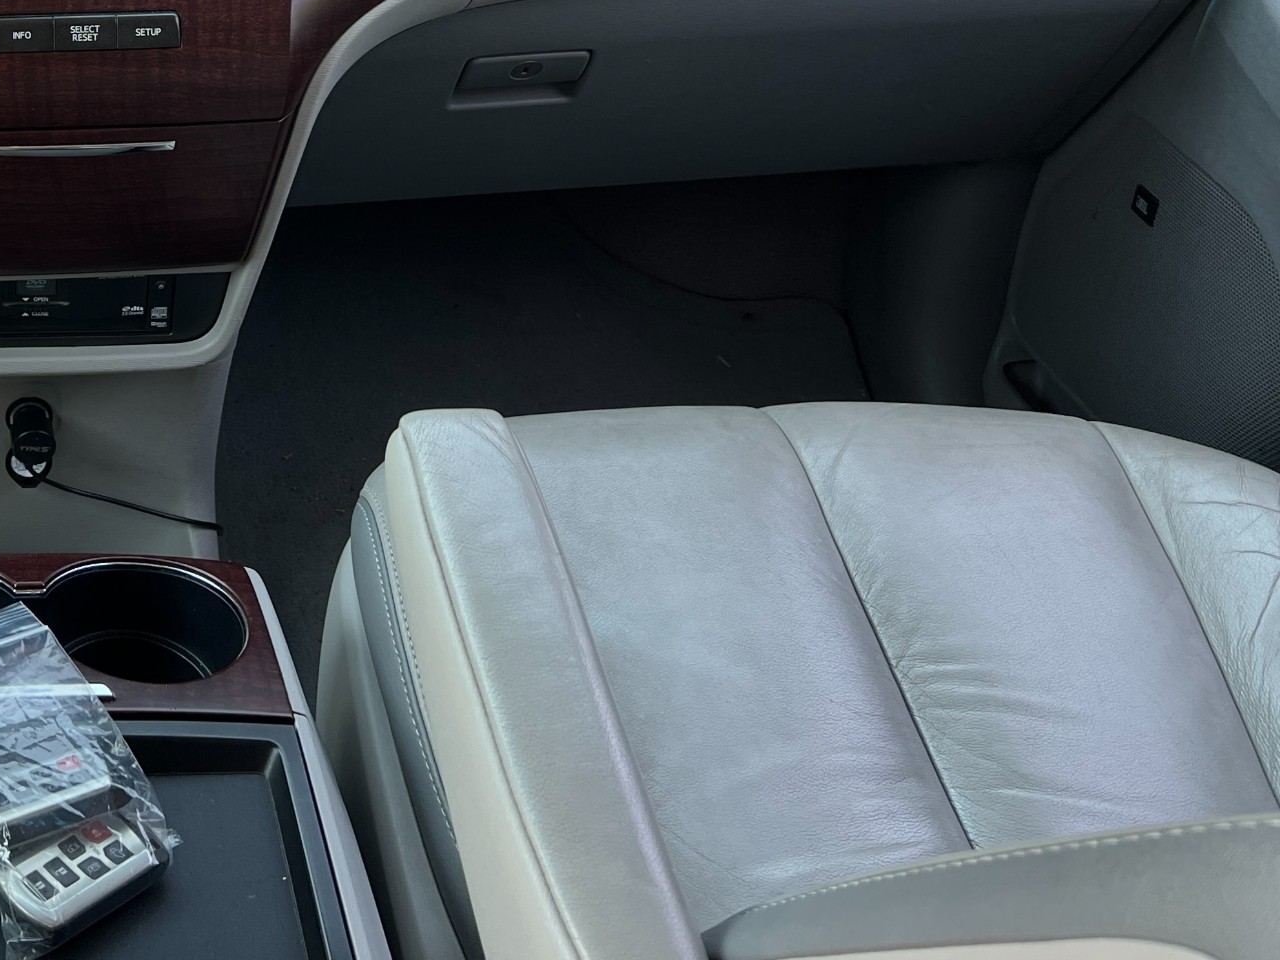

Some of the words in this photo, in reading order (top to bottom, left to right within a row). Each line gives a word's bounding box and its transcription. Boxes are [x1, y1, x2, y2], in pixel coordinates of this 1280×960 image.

[70, 25, 100, 34] SELECT
[135, 28, 162, 37] SETUP
[12, 31, 32, 40] INFO
[71, 33, 98, 42] RESET
